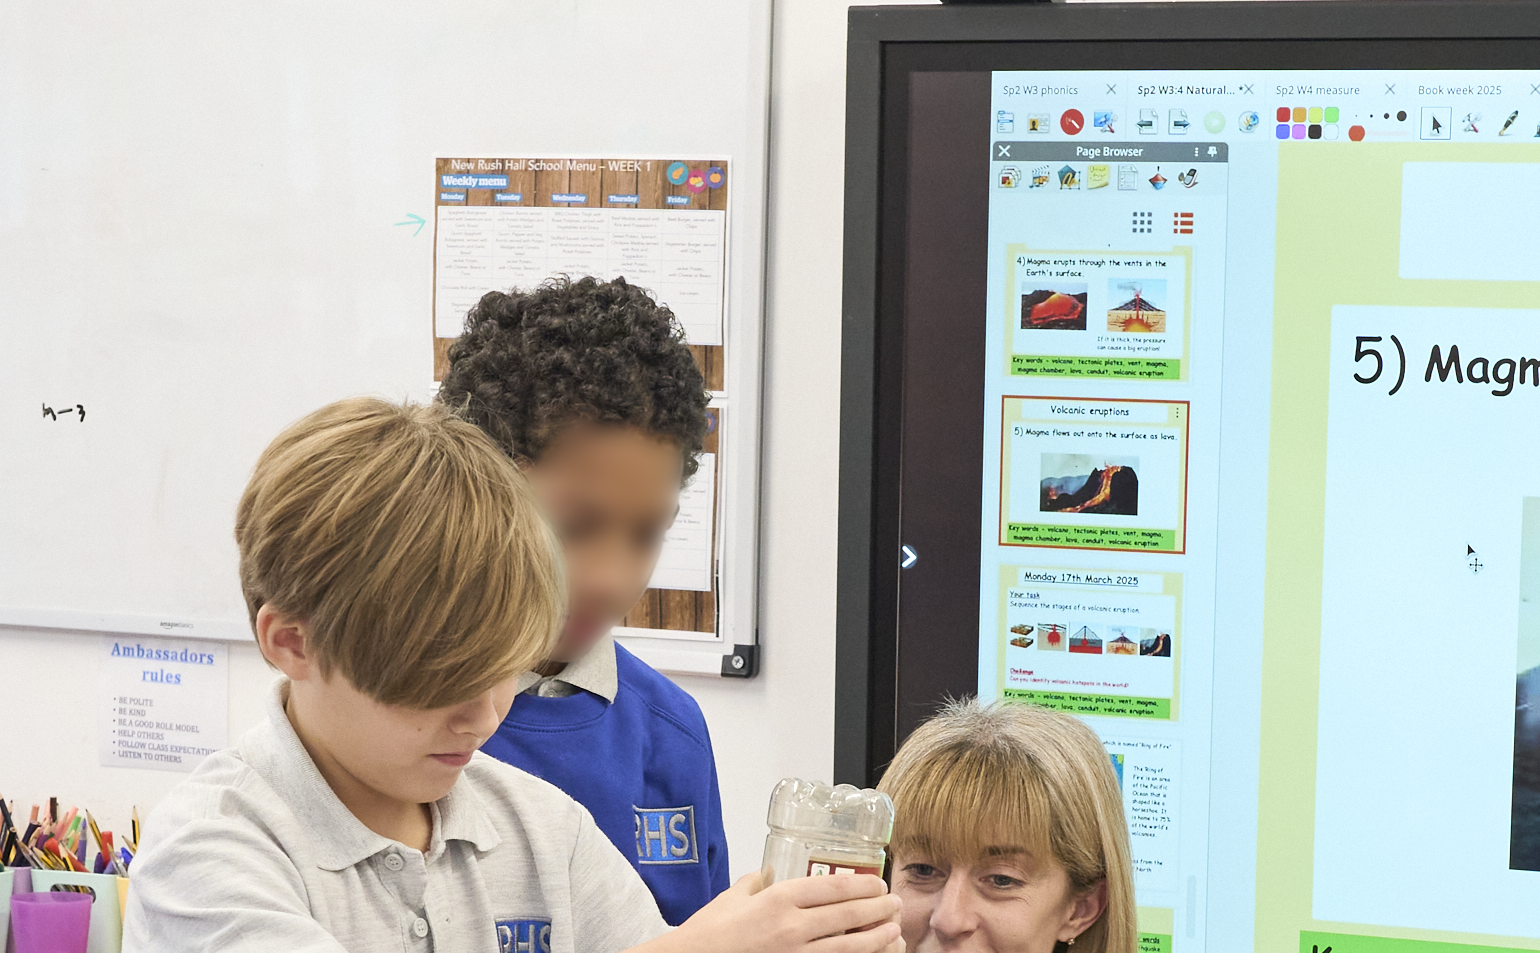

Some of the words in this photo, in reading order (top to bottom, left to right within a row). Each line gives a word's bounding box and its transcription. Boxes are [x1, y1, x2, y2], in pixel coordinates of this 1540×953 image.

[1003, 85, 1021, 97] Sp2
[1022, 85, 1039, 95] W3
[1041, 85, 1078, 97] phonics
[1138, 85, 1156, 97] Sp2
[1158, 85, 1183, 95] W3:4
[1276, 85, 1294, 97] Sp2
[1297, 85, 1313, 96] W4
[1316, 87, 1360, 96] measure
[1418, 85, 1444, 96] Book
[1446, 85, 1474, 96] week
[1477, 86, 1502, 96] 2025
[1076, 146, 1099, 159] Page
[1101, 146, 1143, 158] Browser
[451, 159, 475, 170] New
[478, 160, 502, 170] Rush
[505, 160, 525, 170] Hall
[528, 160, 563, 171] School
[566, 161, 596, 171] Menu
[608, 161, 641, 171] WEEK
[646, 161, 651, 171] 1
[442, 176, 478, 188] Weekly
[478, 178, 507, 186] menu
[441, 193, 464, 201] Monday
[552, 194, 586, 202] Wednesday
[609, 195, 638, 203] Thursday
[667, 196, 688, 204] Friday
[1027, 258, 1051, 266] Magma
[1054, 259, 1076, 267] erupts
[1079, 259, 1105, 268] through
[1353, 335, 1406, 396] 5)
[1050, 405, 1086, 415] Volcanic
[1090, 407, 1129, 417] eruptions
[1014, 426, 1023, 436] 5)
[1026, 429, 1049, 438] Magma
[1052, 429, 1070, 437] flows
[1088, 430, 1102, 438] onto
[1120, 432, 1146, 440] surface
[1134, 539, 1159, 547] eruption
[1025, 572, 1056, 583] Monday
[1061, 573, 1082, 582] 17th
[1085, 575, 1112, 584] March
[1116, 576, 1138, 586] 2025
[1010, 600, 1038, 609] Sequence
[111, 642, 214, 665] Ambassadors
[142, 668, 182, 684] rules
[129, 697, 154, 707] POLITE
[118, 707, 127, 715] BE
[129, 708, 146, 717] KIND
[118, 718, 127, 726] BE
[135, 720, 154, 728] GOOD
[156, 722, 174, 730] ROLE
[176, 724, 200, 733] MODEL
[118, 730, 136, 738] HELP
[137, 731, 164, 740] OTHERS
[118, 740, 146, 749] FOLLOW
[148, 742, 168, 752] CLASS
[118, 750, 142, 759] LISTEN
[144, 752, 153, 760] TO
[155, 754, 182, 763] OTHERS
[634, 812, 689, 858] HS
